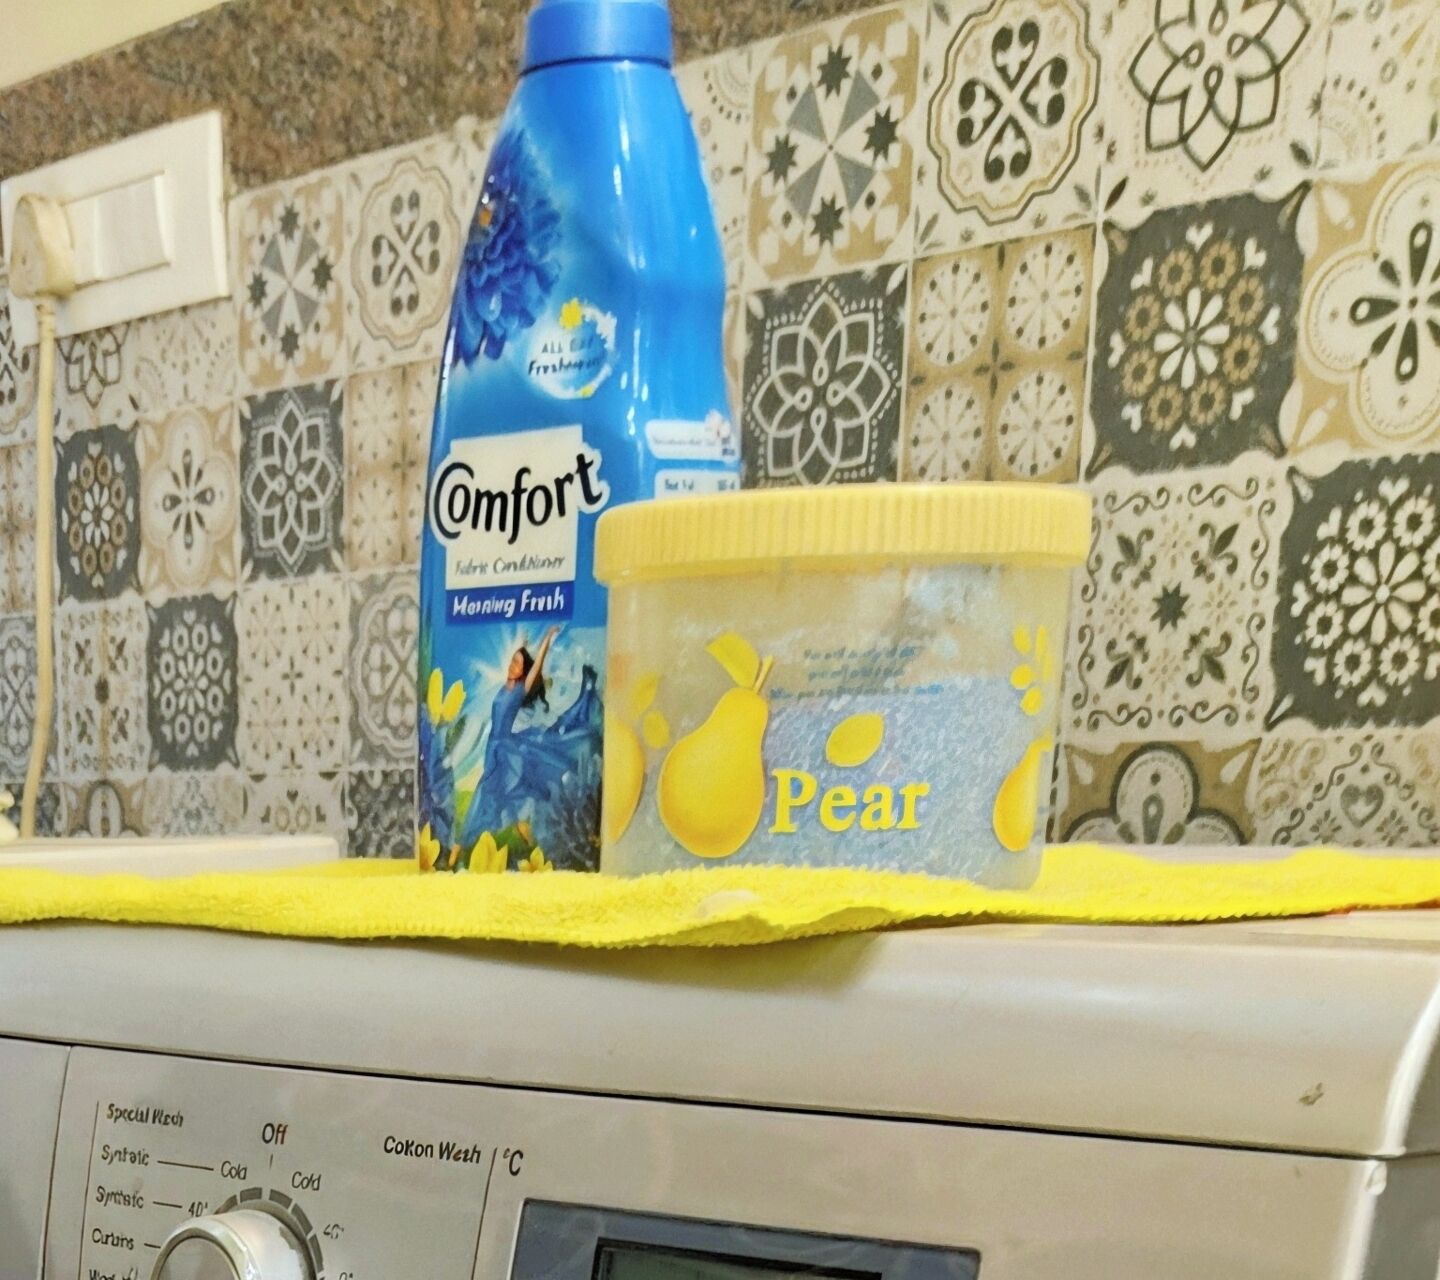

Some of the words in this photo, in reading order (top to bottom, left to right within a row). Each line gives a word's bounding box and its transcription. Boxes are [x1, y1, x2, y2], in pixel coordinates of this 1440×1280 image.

[433, 452, 603, 545] Comfort
[452, 594, 517, 618] Morning
[520, 586, 565, 613] Fresh
[768, 768, 931, 834] Pear
[261, 1122, 289, 1146] Off
[383, 1135, 434, 1159] Cotton
[438, 1141, 482, 1165] Wash
[220, 1160, 249, 1181] Cold
[291, 1171, 322, 1192] Cold
